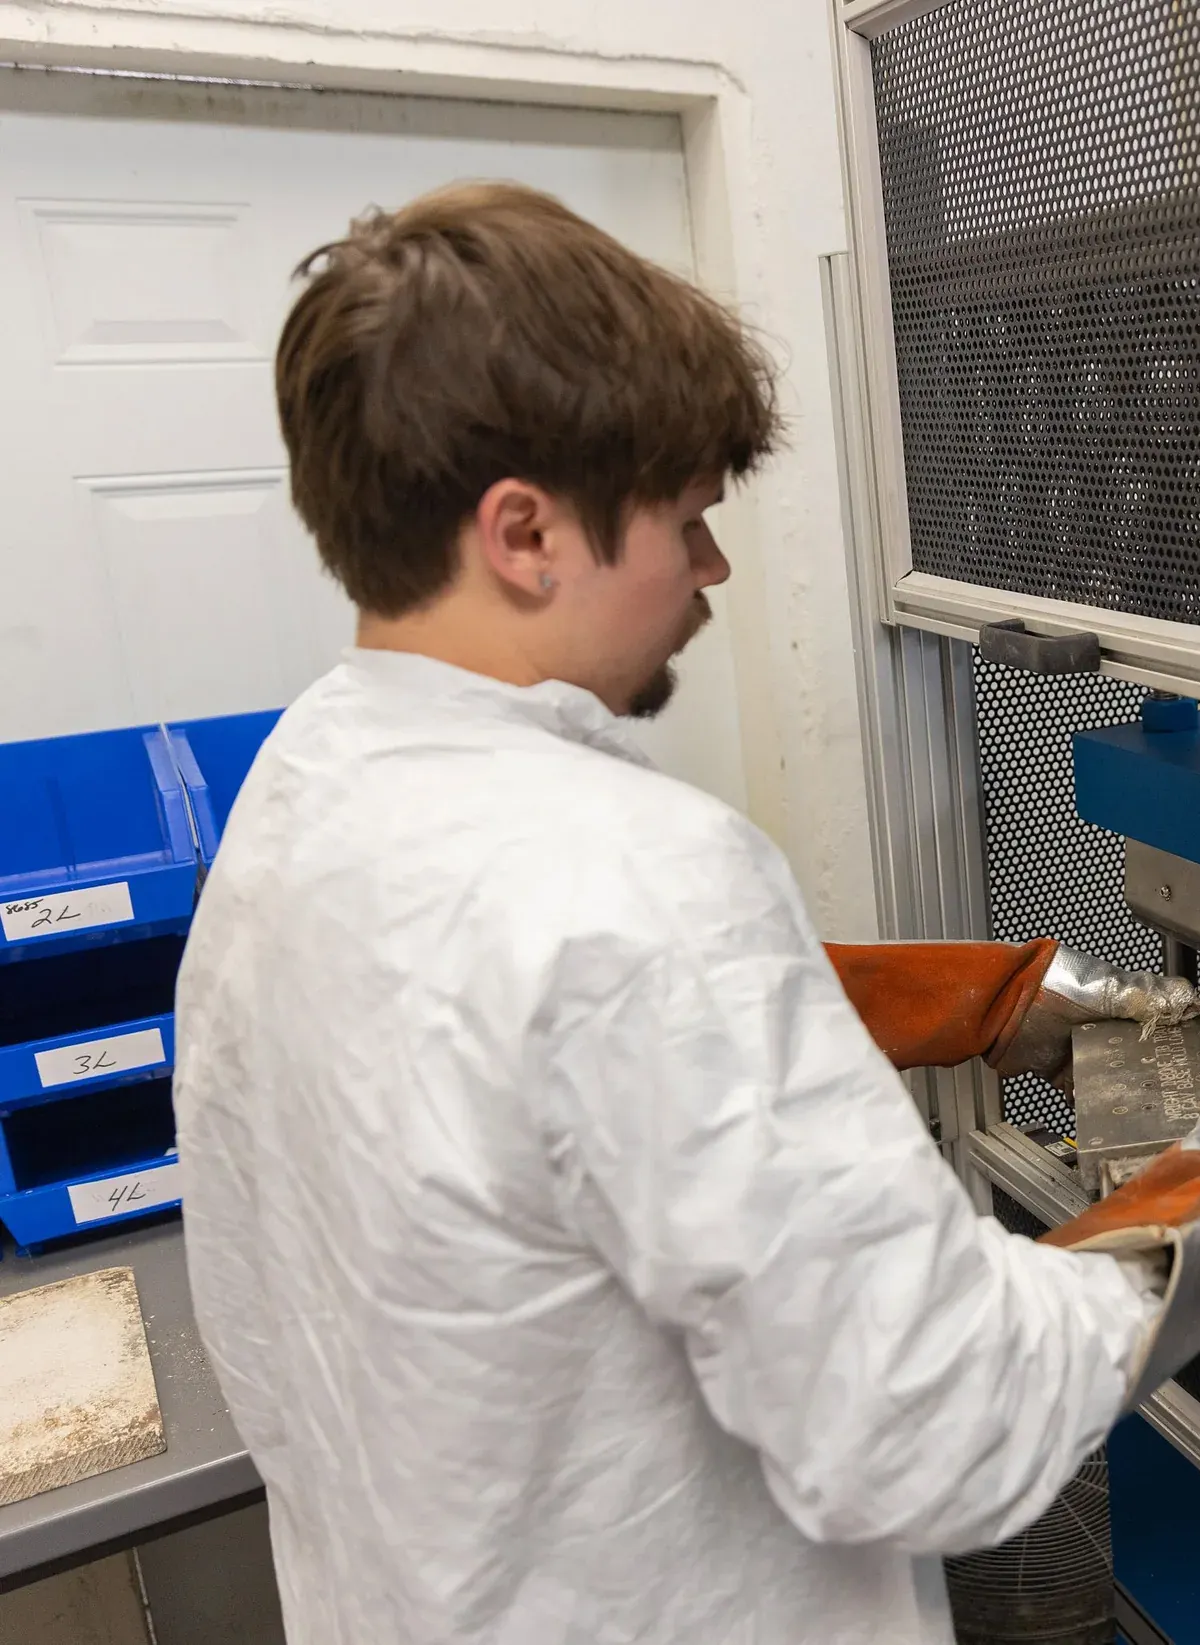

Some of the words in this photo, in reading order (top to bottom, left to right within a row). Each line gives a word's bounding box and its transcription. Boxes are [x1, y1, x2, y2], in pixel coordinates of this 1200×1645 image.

[31, 905, 81, 928] 2L
[73, 1051, 117, 1074] 3L
[108, 1181, 147, 1212] 4L
